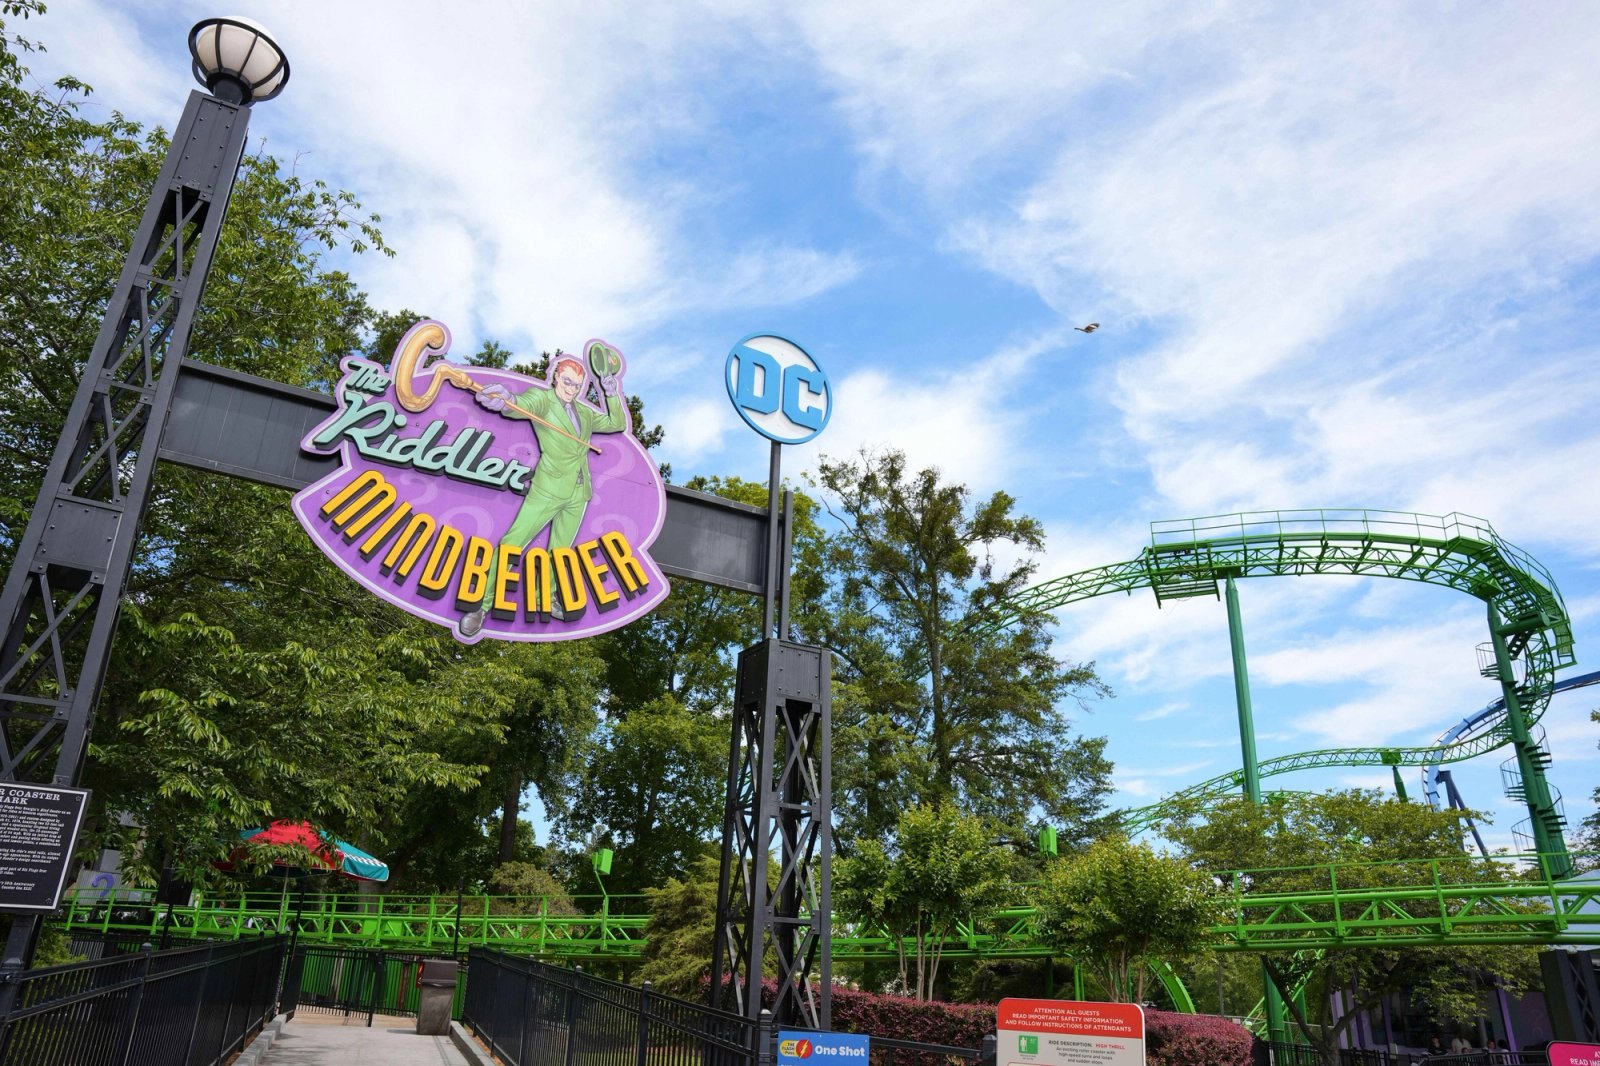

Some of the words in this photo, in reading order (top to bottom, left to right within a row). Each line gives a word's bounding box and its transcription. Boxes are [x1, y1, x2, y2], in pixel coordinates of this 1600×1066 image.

[346, 360, 390, 394] The
[735, 343, 824, 432] DC
[313, 391, 533, 492] Riddler
[320, 470, 651, 617] MINDBENDER
[9, 789, 61, 801] COASTER
[1028, 1013, 1060, 1021] IMPORTANT
[1083, 1017, 1124, 1025] INFORMATION
[1042, 1021, 1083, 1029] INSTRUCTIONS
[1093, 1024, 1132, 1032] ATTENDANTS
[814, 1045, 838, 1056] One
[838, 1045, 866, 1057] Shot
[1569, 1057, 1589, 1066] READ
